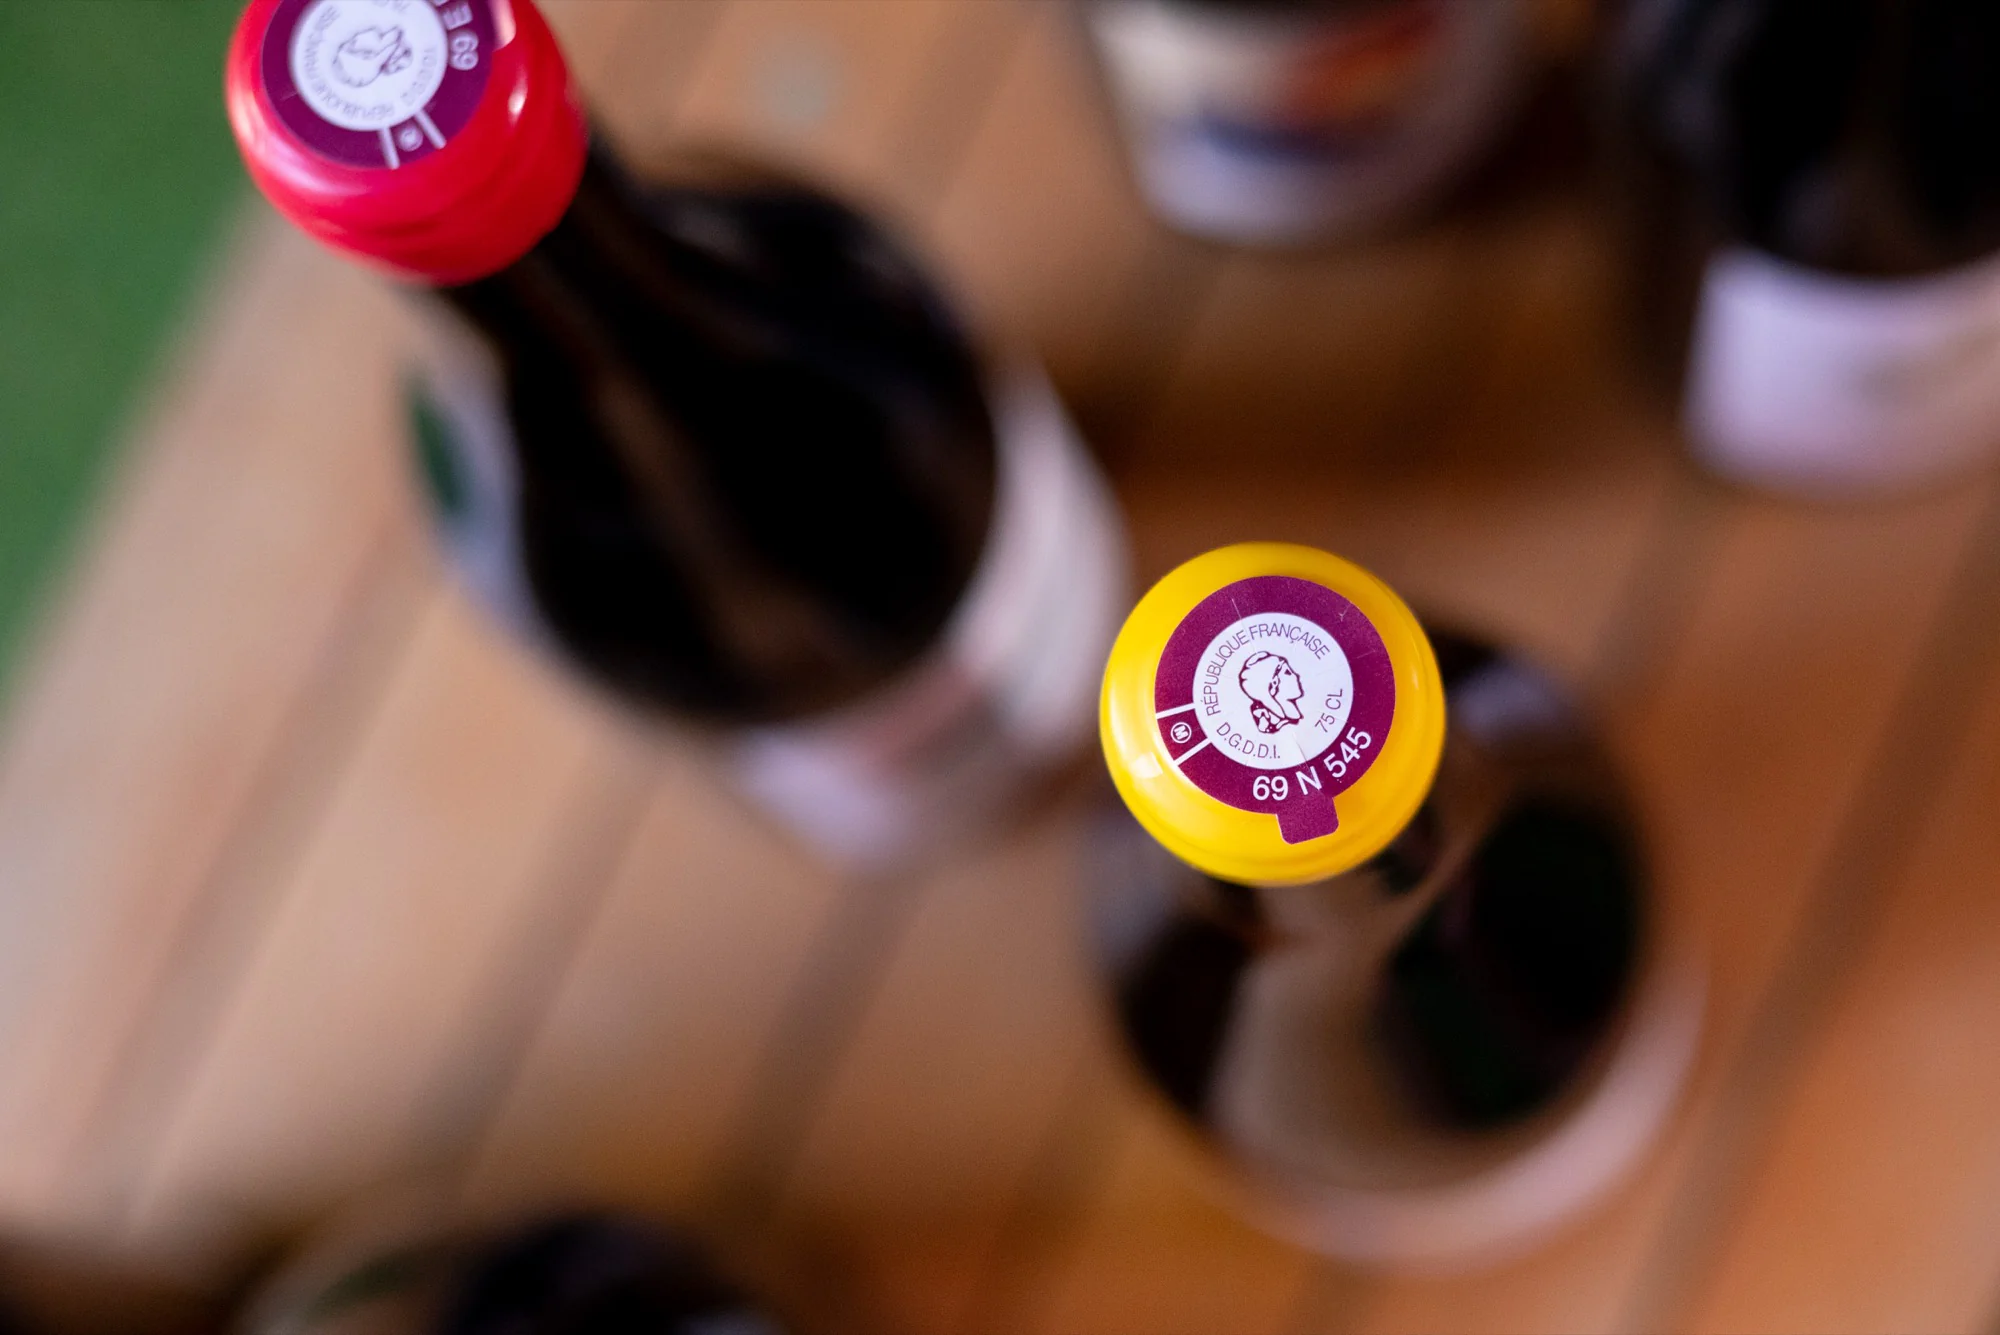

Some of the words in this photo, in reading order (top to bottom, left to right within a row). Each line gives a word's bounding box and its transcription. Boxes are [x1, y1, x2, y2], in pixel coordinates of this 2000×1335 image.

[450, 31, 479, 70] 69
[1202, 630, 1250, 716] RÉPUBLIQUE
[1249, 622, 1330, 660] FRANÇAISE
[1315, 712, 1335, 733] 75
[1325, 688, 1343, 710] CL
[1216, 722, 1281, 760] D.G.D.D.I.
[1253, 775, 1289, 801] 69
[1296, 766, 1322, 796] N
[1323, 726, 1372, 778] 545
